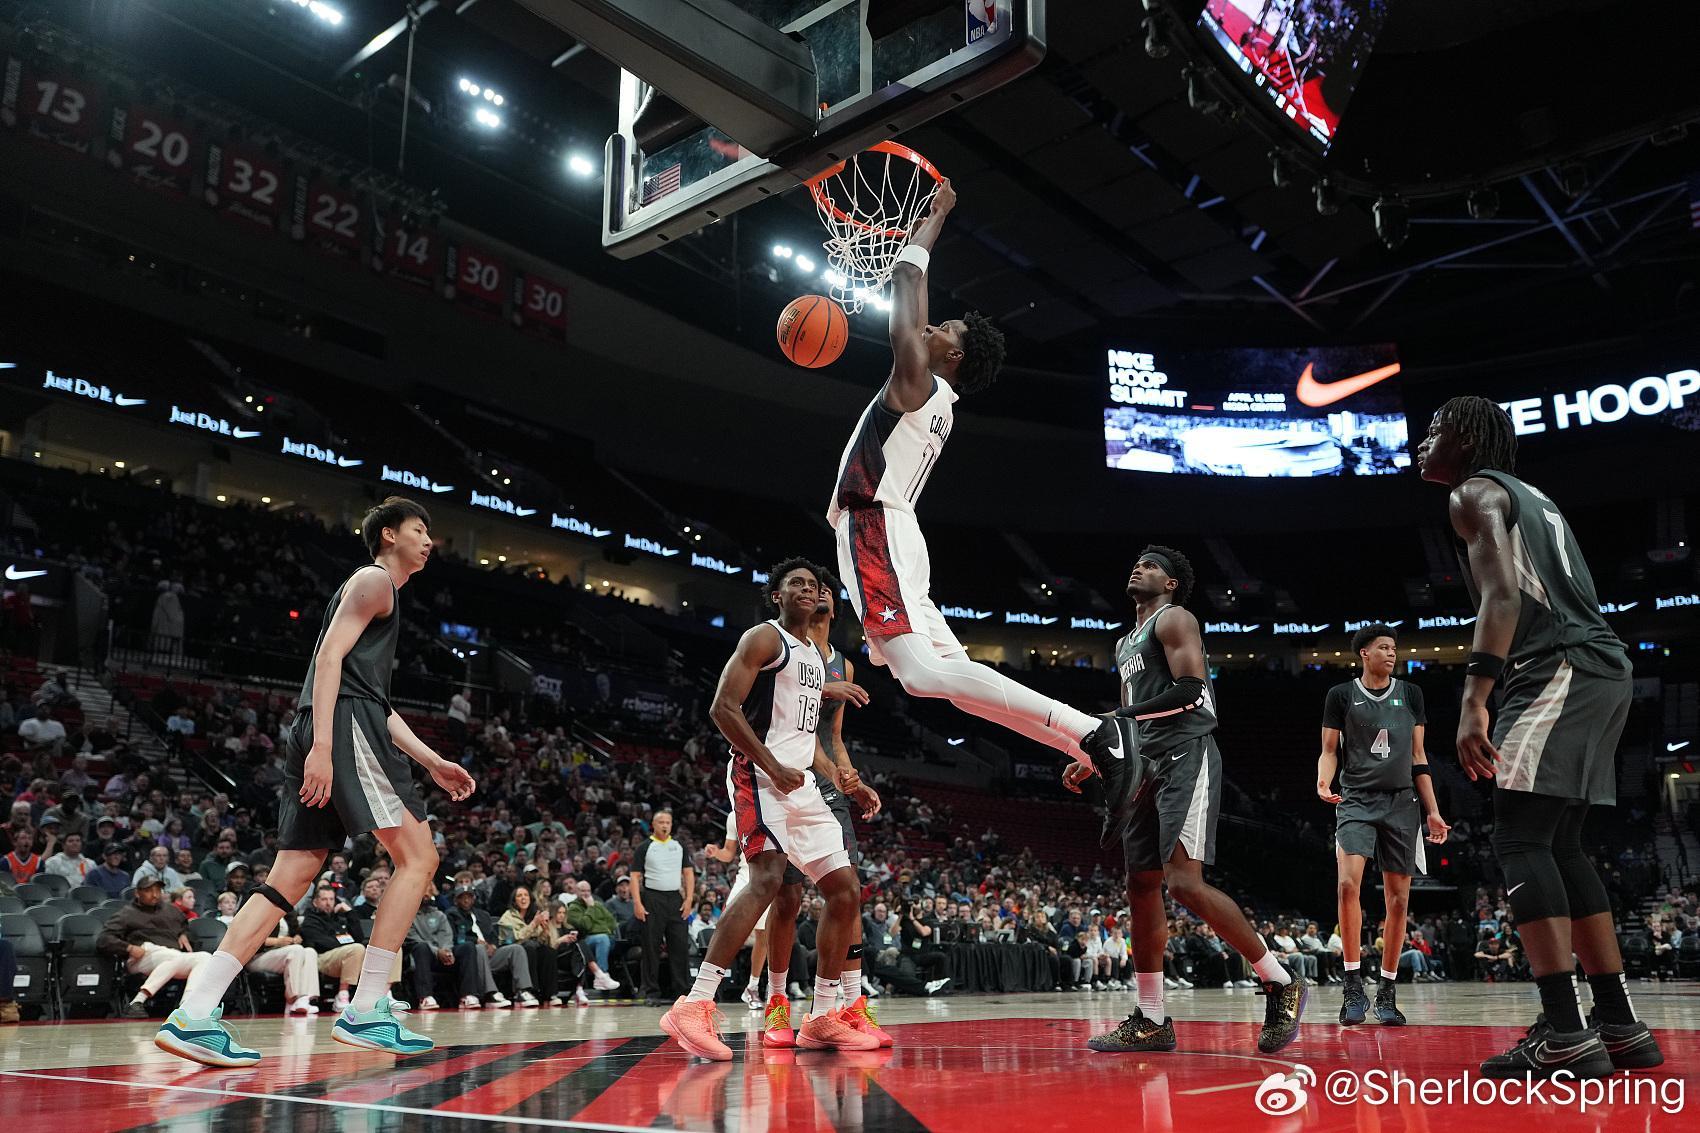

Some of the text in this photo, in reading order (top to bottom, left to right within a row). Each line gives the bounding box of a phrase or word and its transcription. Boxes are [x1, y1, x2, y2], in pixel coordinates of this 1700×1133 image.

[970, 24, 985, 42] NBA
[35, 80, 86, 124] 13
[133, 119, 190, 167] 20
[228, 158, 279, 205] 32
[312, 193, 359, 238] 22
[395, 227, 429, 265] 14
[462, 256, 500, 291] 30
[527, 284, 562, 317] 30
[1107, 349, 1155, 371] NIKE
[43, 371, 72, 391] Just
[75, 379, 98, 398] Do
[1109, 368, 1168, 390] HOOP
[1110, 386, 1188, 408] SUMMIT
[1553, 369, 1700, 430] HOOP
[169, 406, 196, 425] Just
[197, 413, 218, 431] Do
[281, 437, 305, 456] Just
[306, 444, 325, 461] Do
[381, 465, 402, 483] Just
[403, 471, 421, 487] Do
[470, 490, 490, 507] Just
[490, 496, 506, 511] Do
[551, 513, 569, 529] Just
[1542, 507, 1572, 578] 7
[798, 661, 822, 691] USA
[797, 694, 819, 734] 13
[1370, 728, 1391, 759] 4
